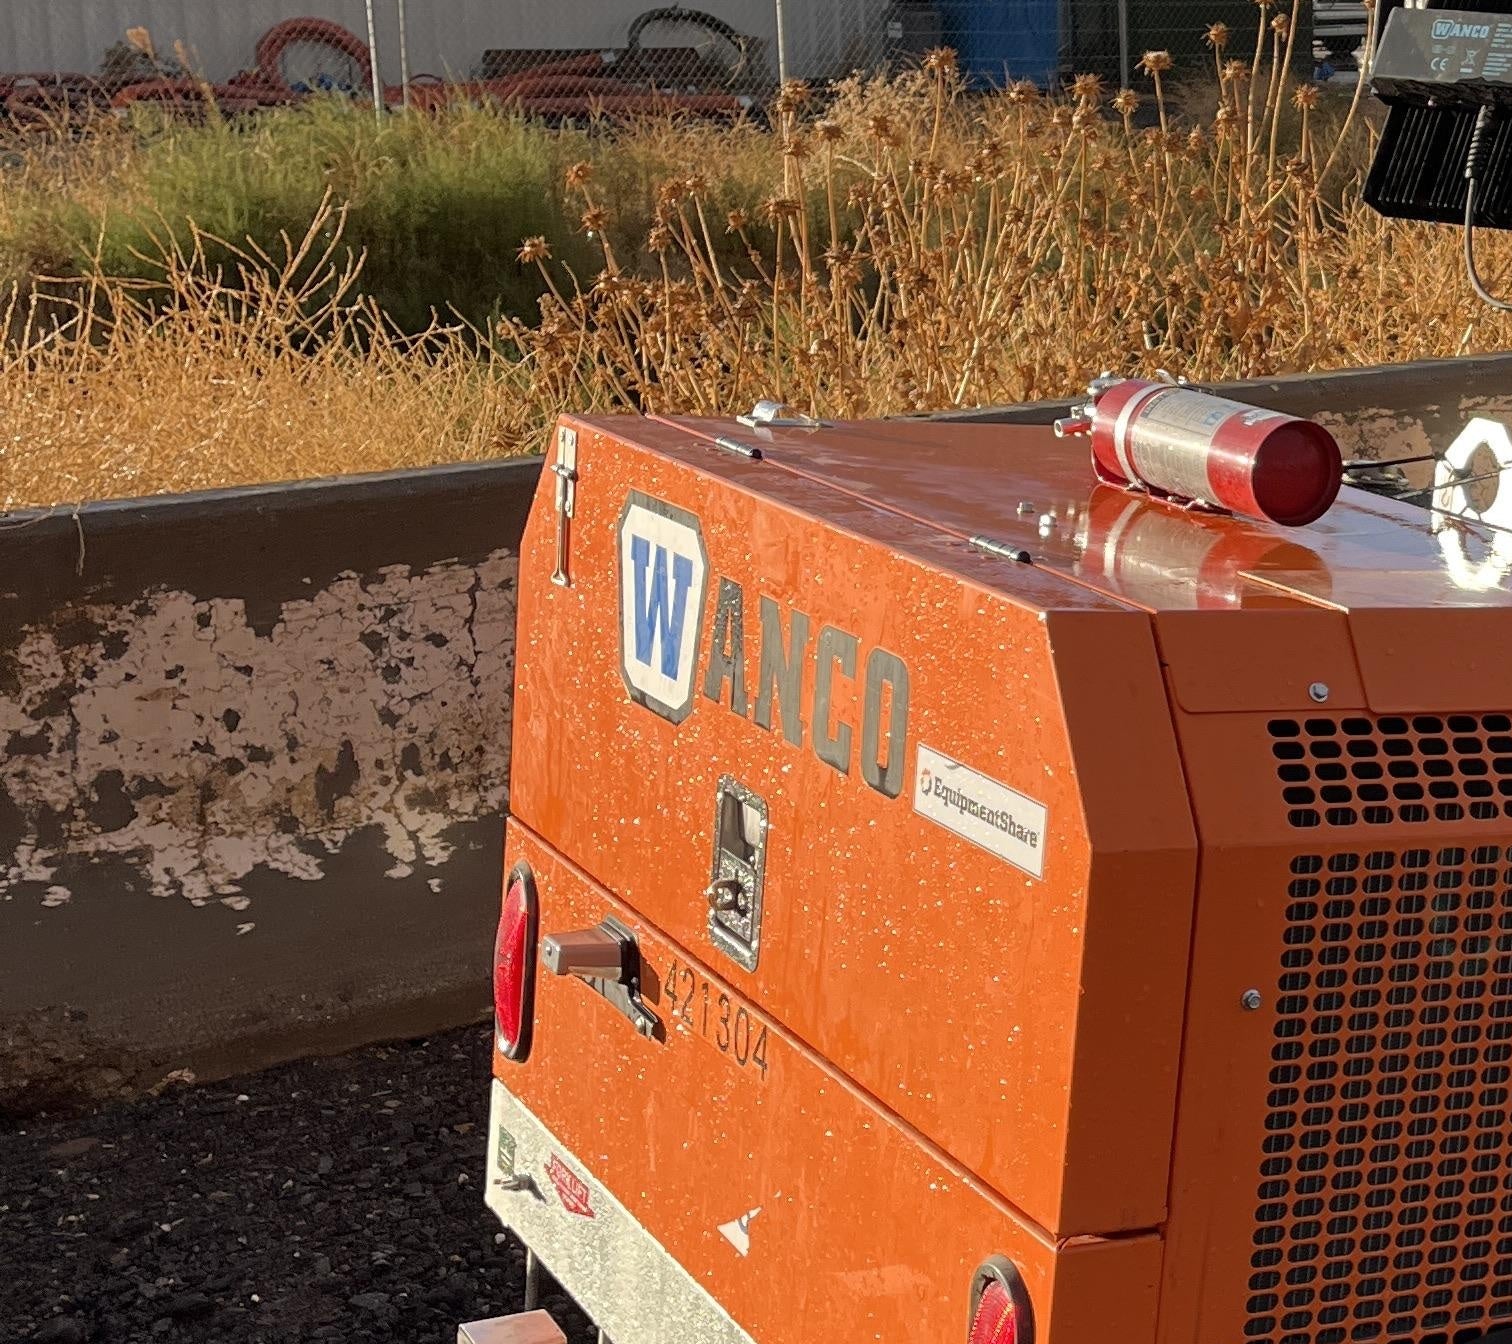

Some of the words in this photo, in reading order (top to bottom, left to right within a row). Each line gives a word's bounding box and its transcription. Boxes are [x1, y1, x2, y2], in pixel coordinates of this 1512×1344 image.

[1432, 20, 1490, 39] WANCO
[625, 506, 911, 801] WANCO
[933, 776, 1038, 849] EquipmentShare
[663, 958, 768, 1082] 421304
